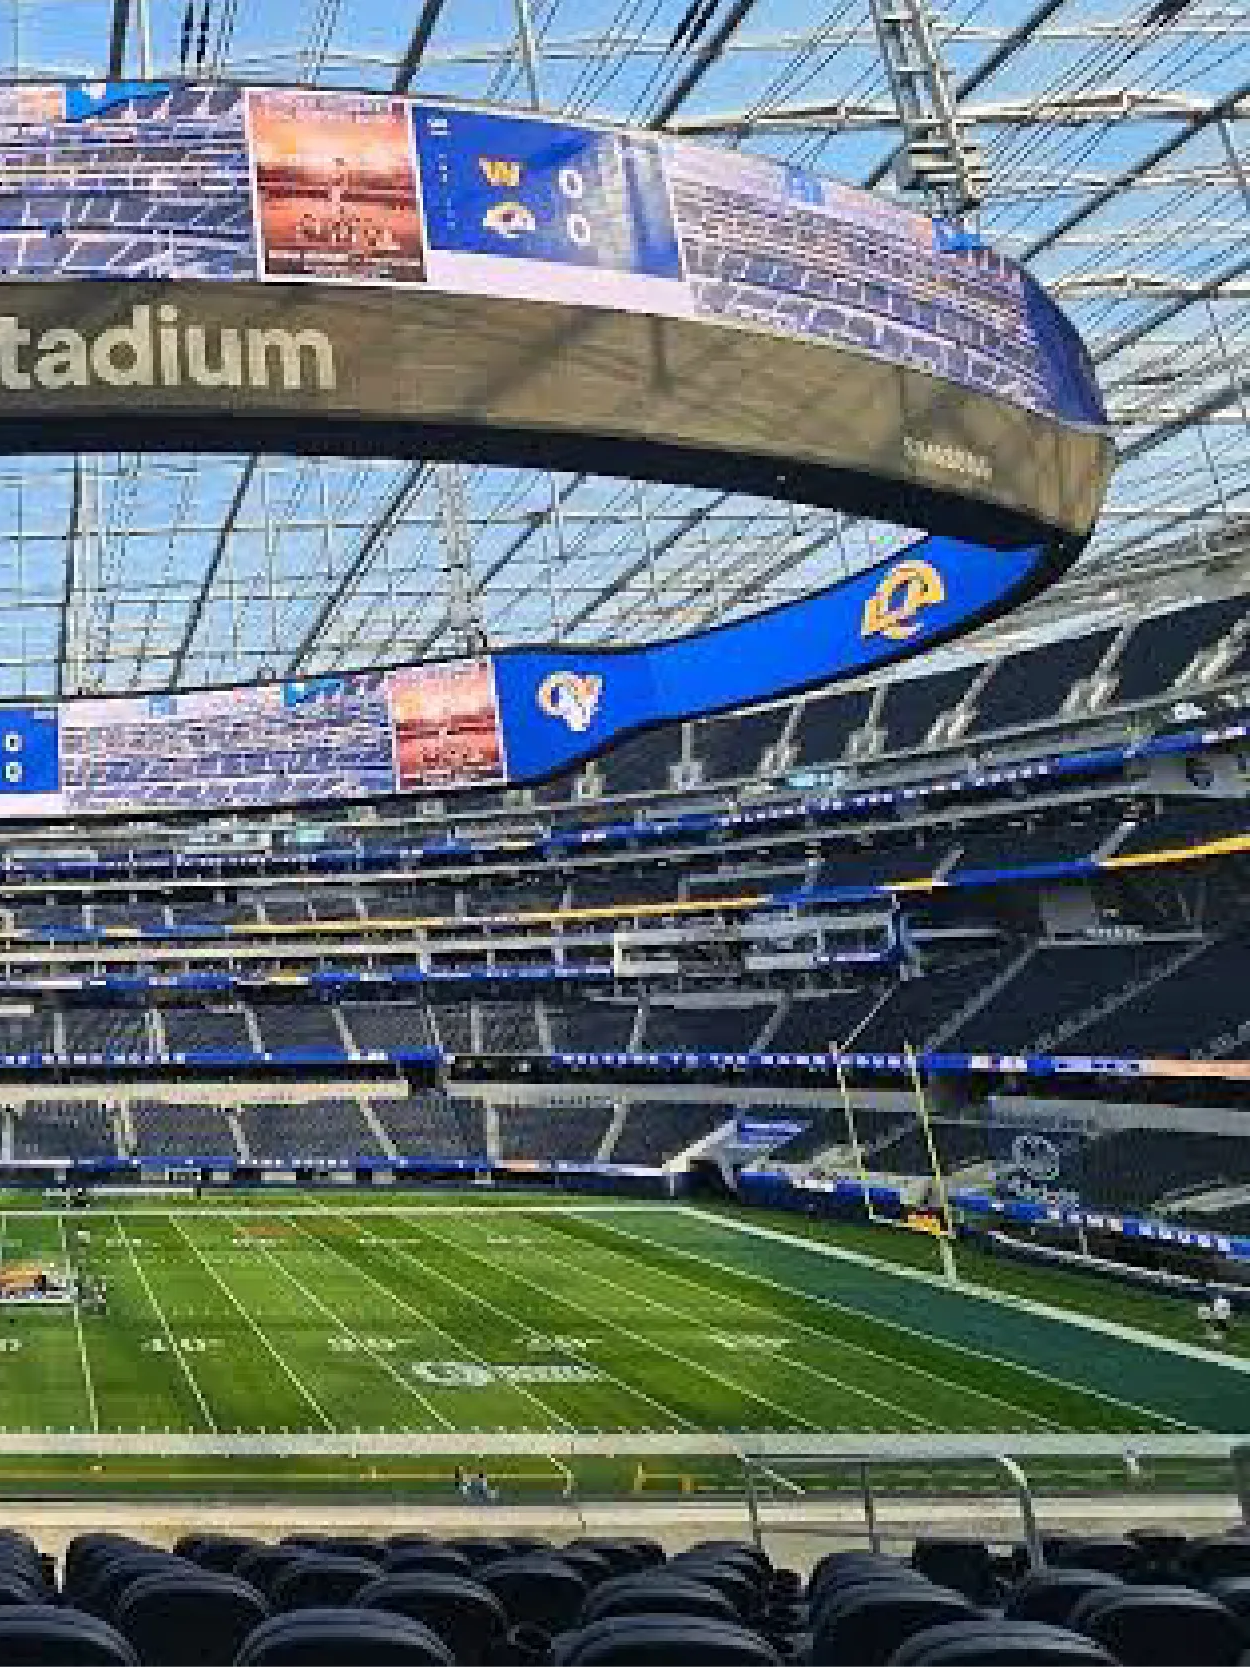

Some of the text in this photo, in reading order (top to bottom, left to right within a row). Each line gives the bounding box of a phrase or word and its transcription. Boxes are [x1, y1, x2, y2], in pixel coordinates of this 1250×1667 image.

[558, 168, 583, 199] 0
[565, 213, 591, 246] 0
[5, 731, 23, 752] 0
[5, 761, 23, 783] 0
